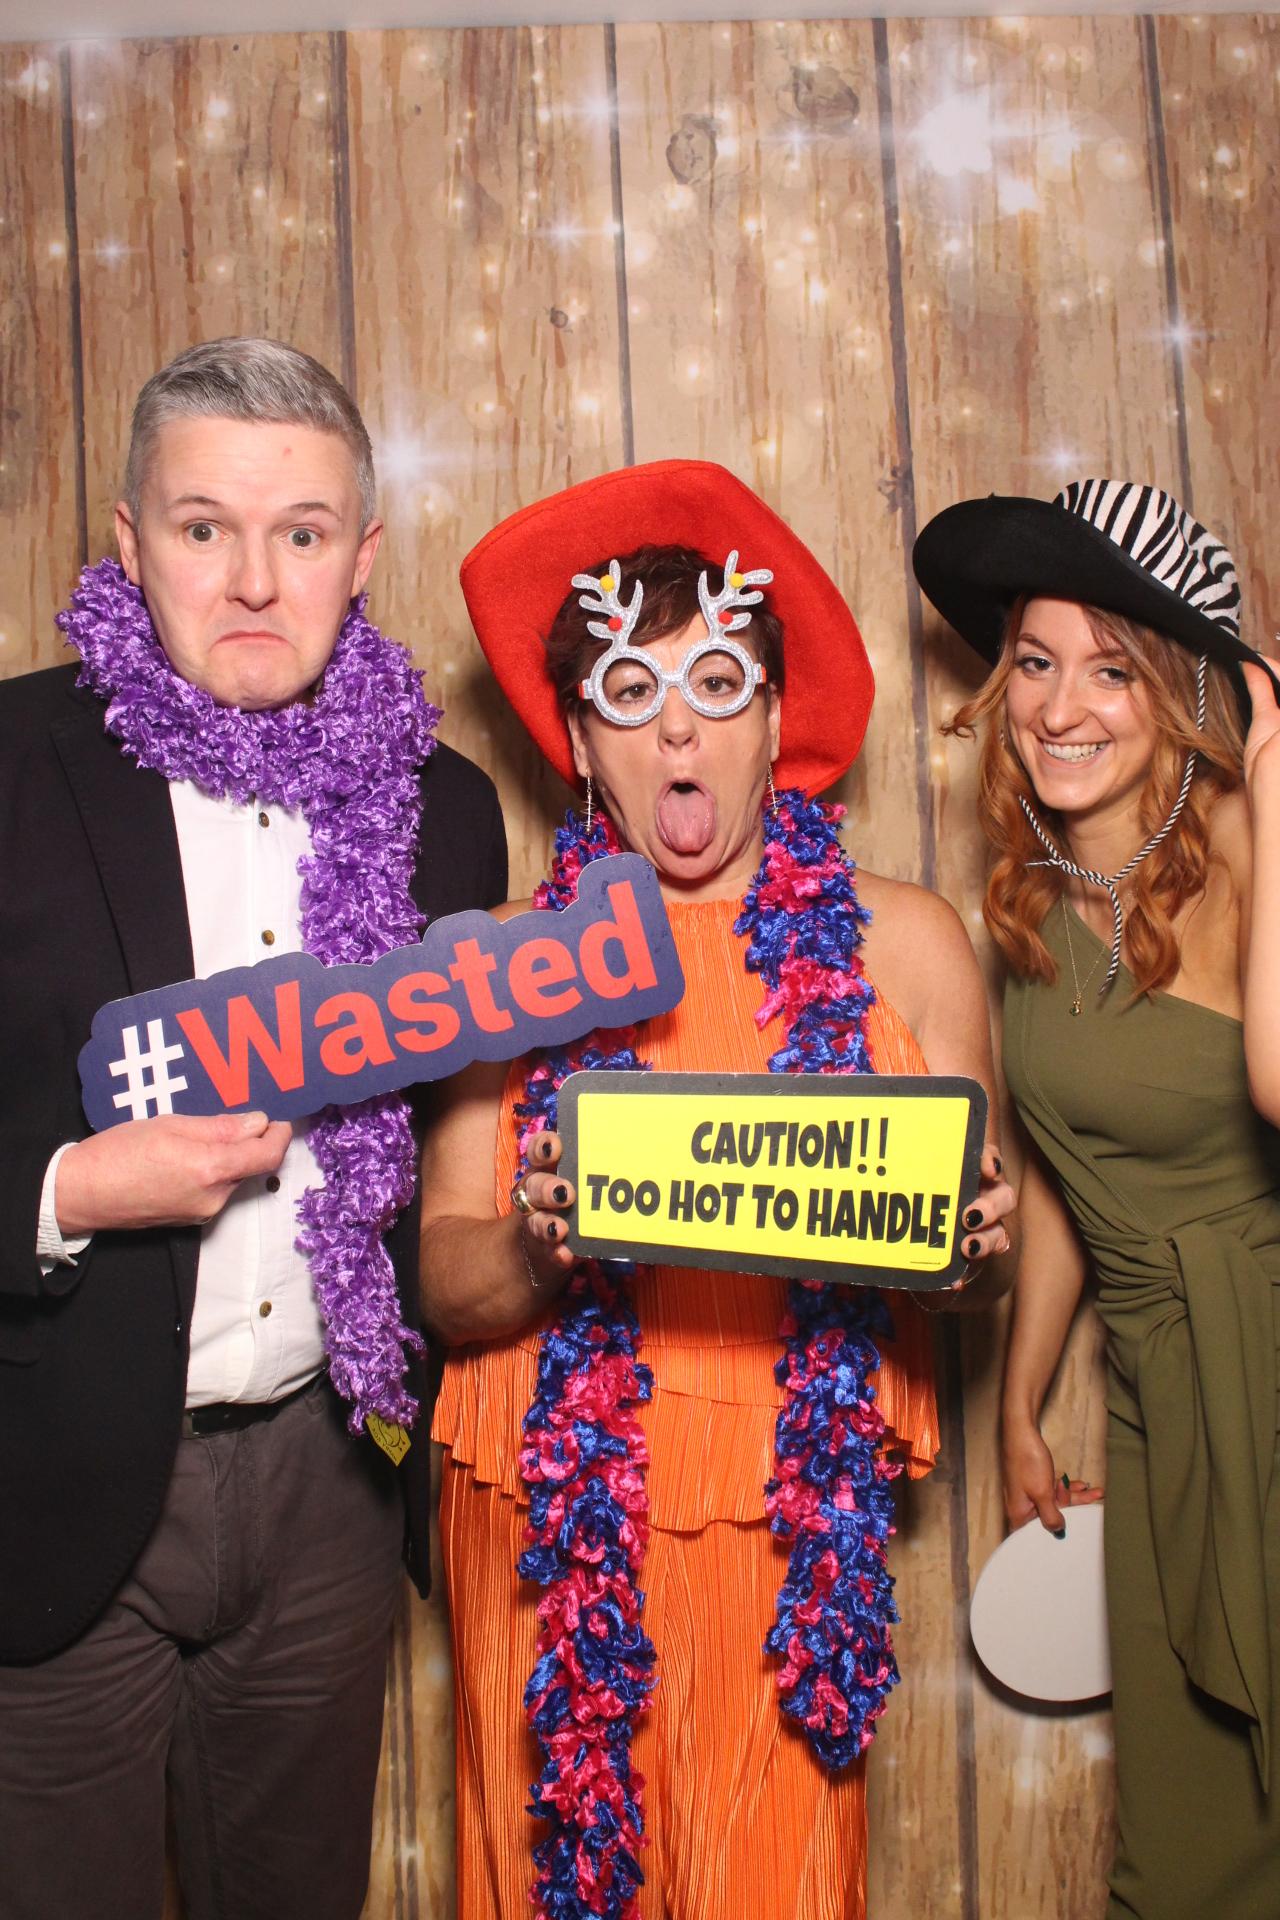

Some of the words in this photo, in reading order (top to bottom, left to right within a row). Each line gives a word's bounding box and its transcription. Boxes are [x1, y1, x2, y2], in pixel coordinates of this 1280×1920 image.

[108, 880, 658, 1120] #Wasted
[691, 1117, 889, 1177] CAUTION!!
[586, 1174, 661, 1217] TOO
[668, 1179, 744, 1226] HOT
[752, 1183, 799, 1232] TO
[806, 1187, 951, 1249] HANDLE
